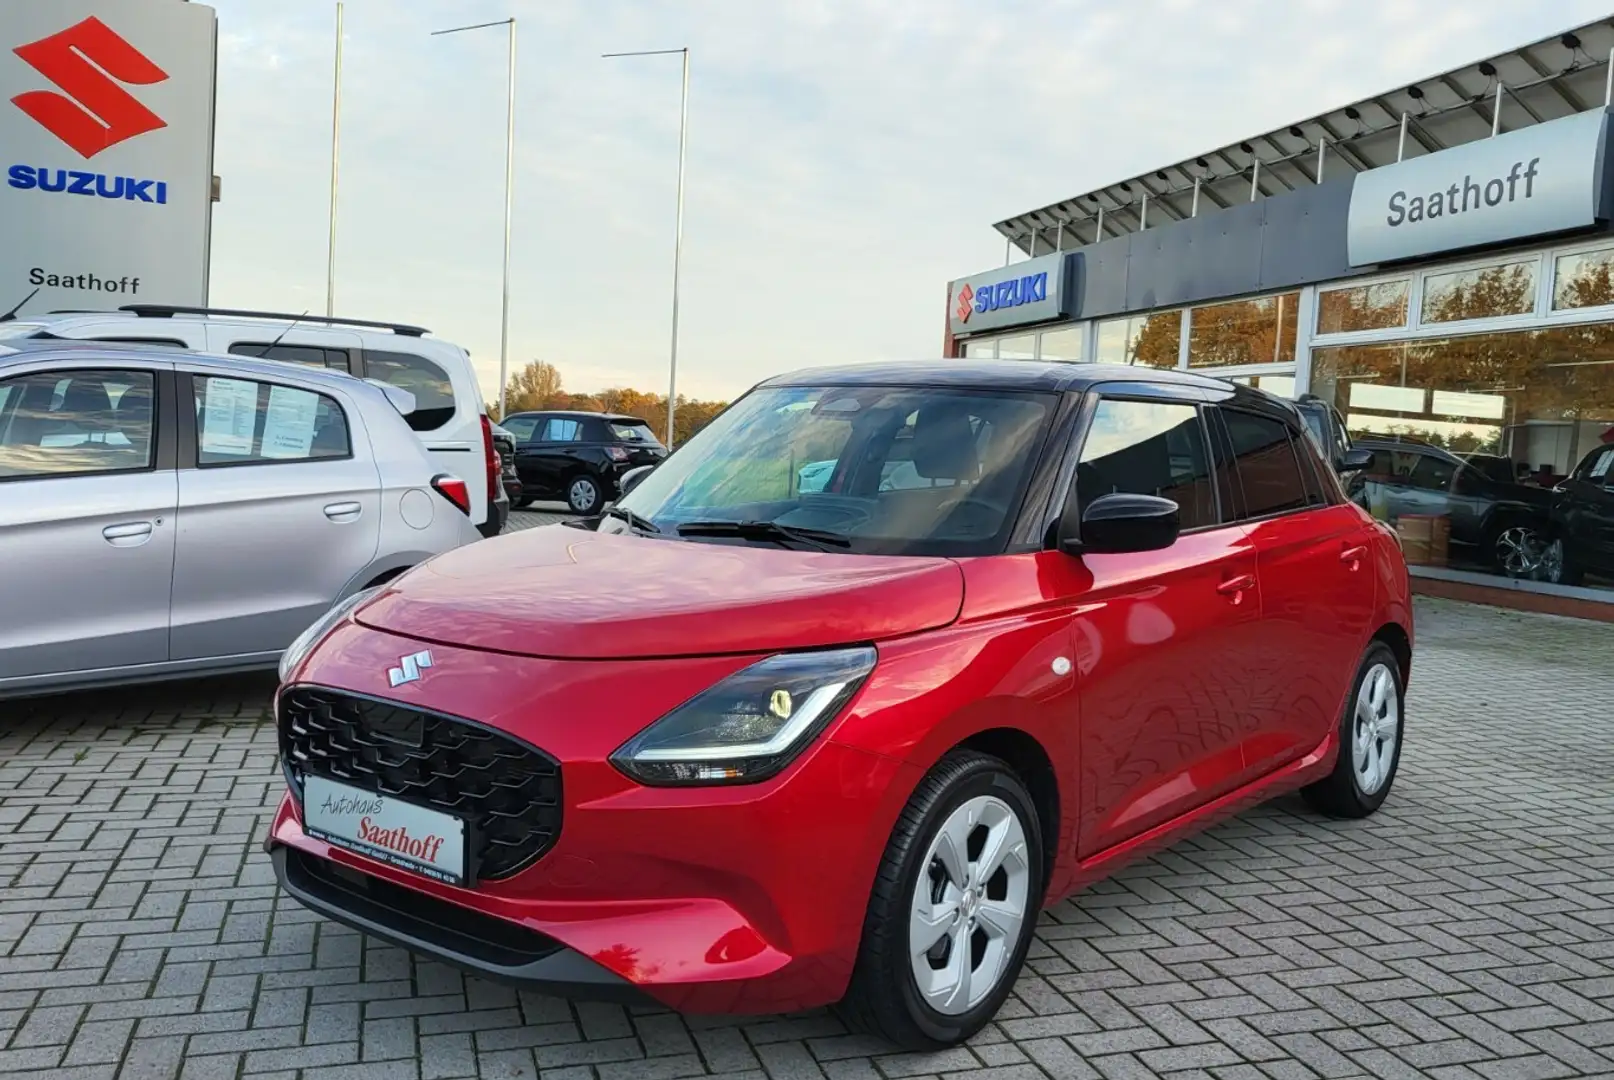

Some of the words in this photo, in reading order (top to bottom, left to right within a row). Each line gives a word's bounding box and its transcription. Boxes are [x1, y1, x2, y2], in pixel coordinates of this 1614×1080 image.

[8, 165, 167, 204] SUZUKI
[1387, 157, 1540, 227] Saathoff
[29, 267, 140, 294] Saathoff
[975, 272, 1047, 313] SUZUKI
[320, 793, 384, 815] Autohaus
[357, 816, 444, 863] Saathoff
